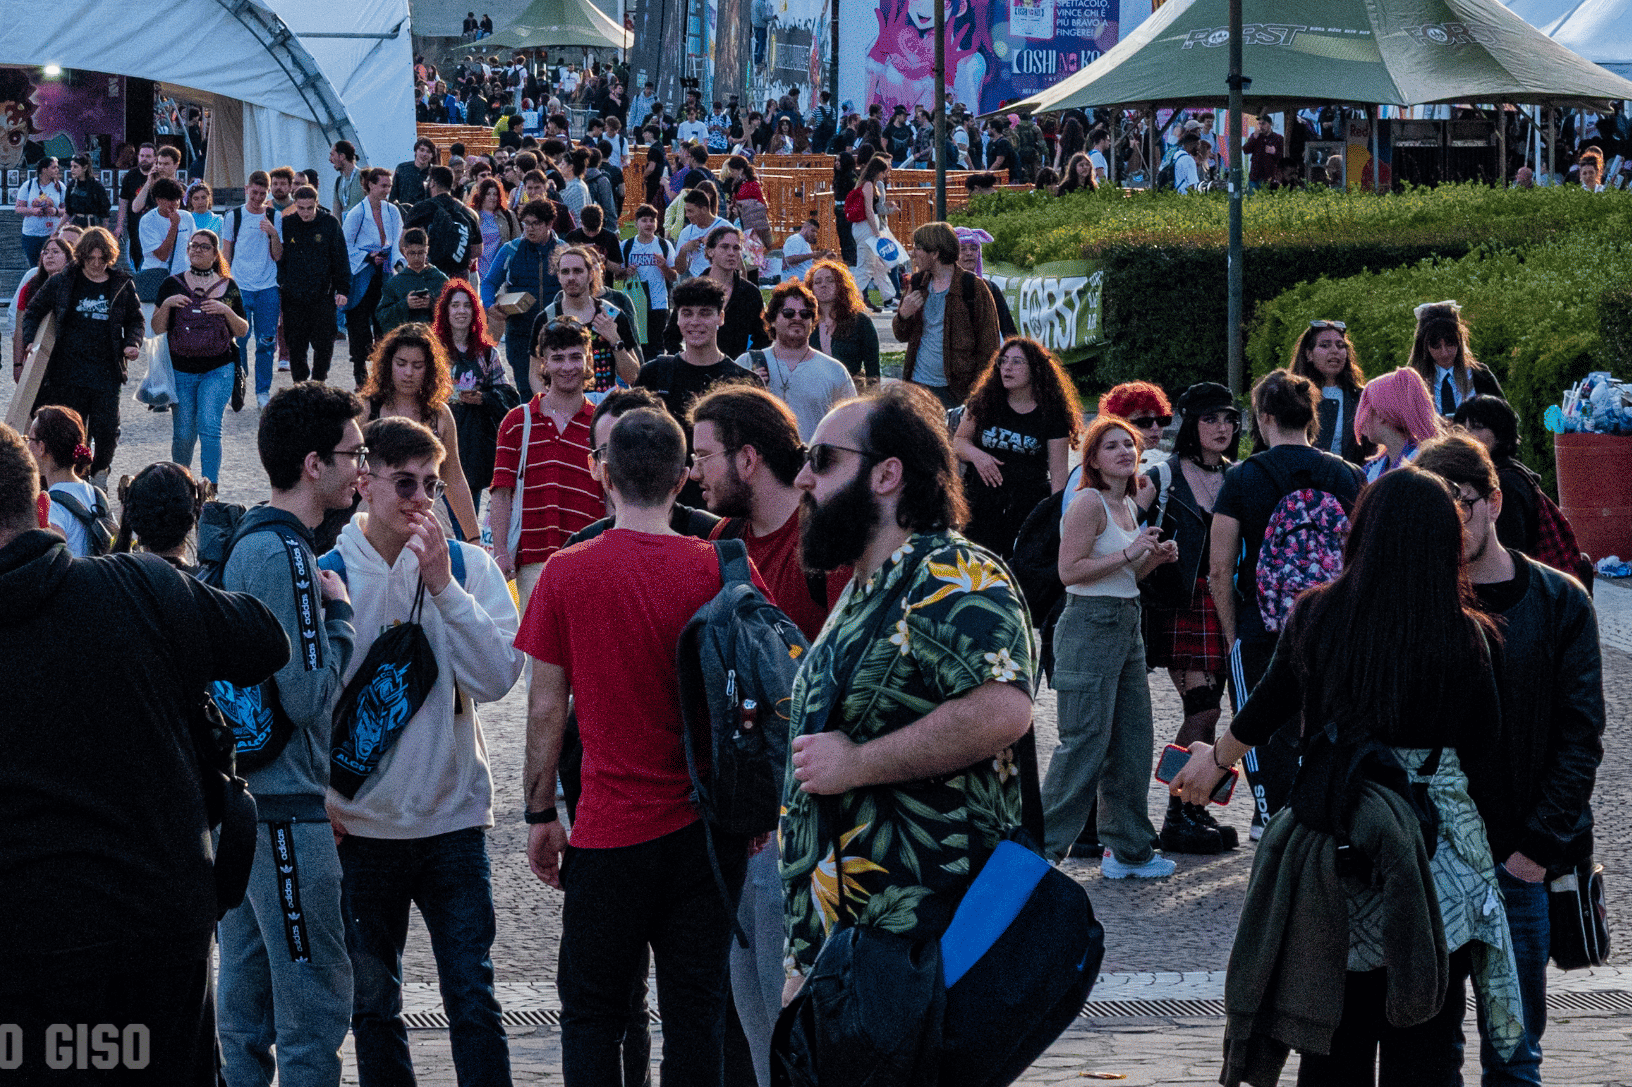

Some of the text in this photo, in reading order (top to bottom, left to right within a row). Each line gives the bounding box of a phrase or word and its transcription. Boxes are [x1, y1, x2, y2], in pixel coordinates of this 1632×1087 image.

[1056, 9, 1083, 17] VINCE
[1084, 9, 1099, 17] CHI
[1071, 18, 1100, 27] BRAVO
[301, 593, 311, 625] adidas
[277, 828, 288, 861] adidas
